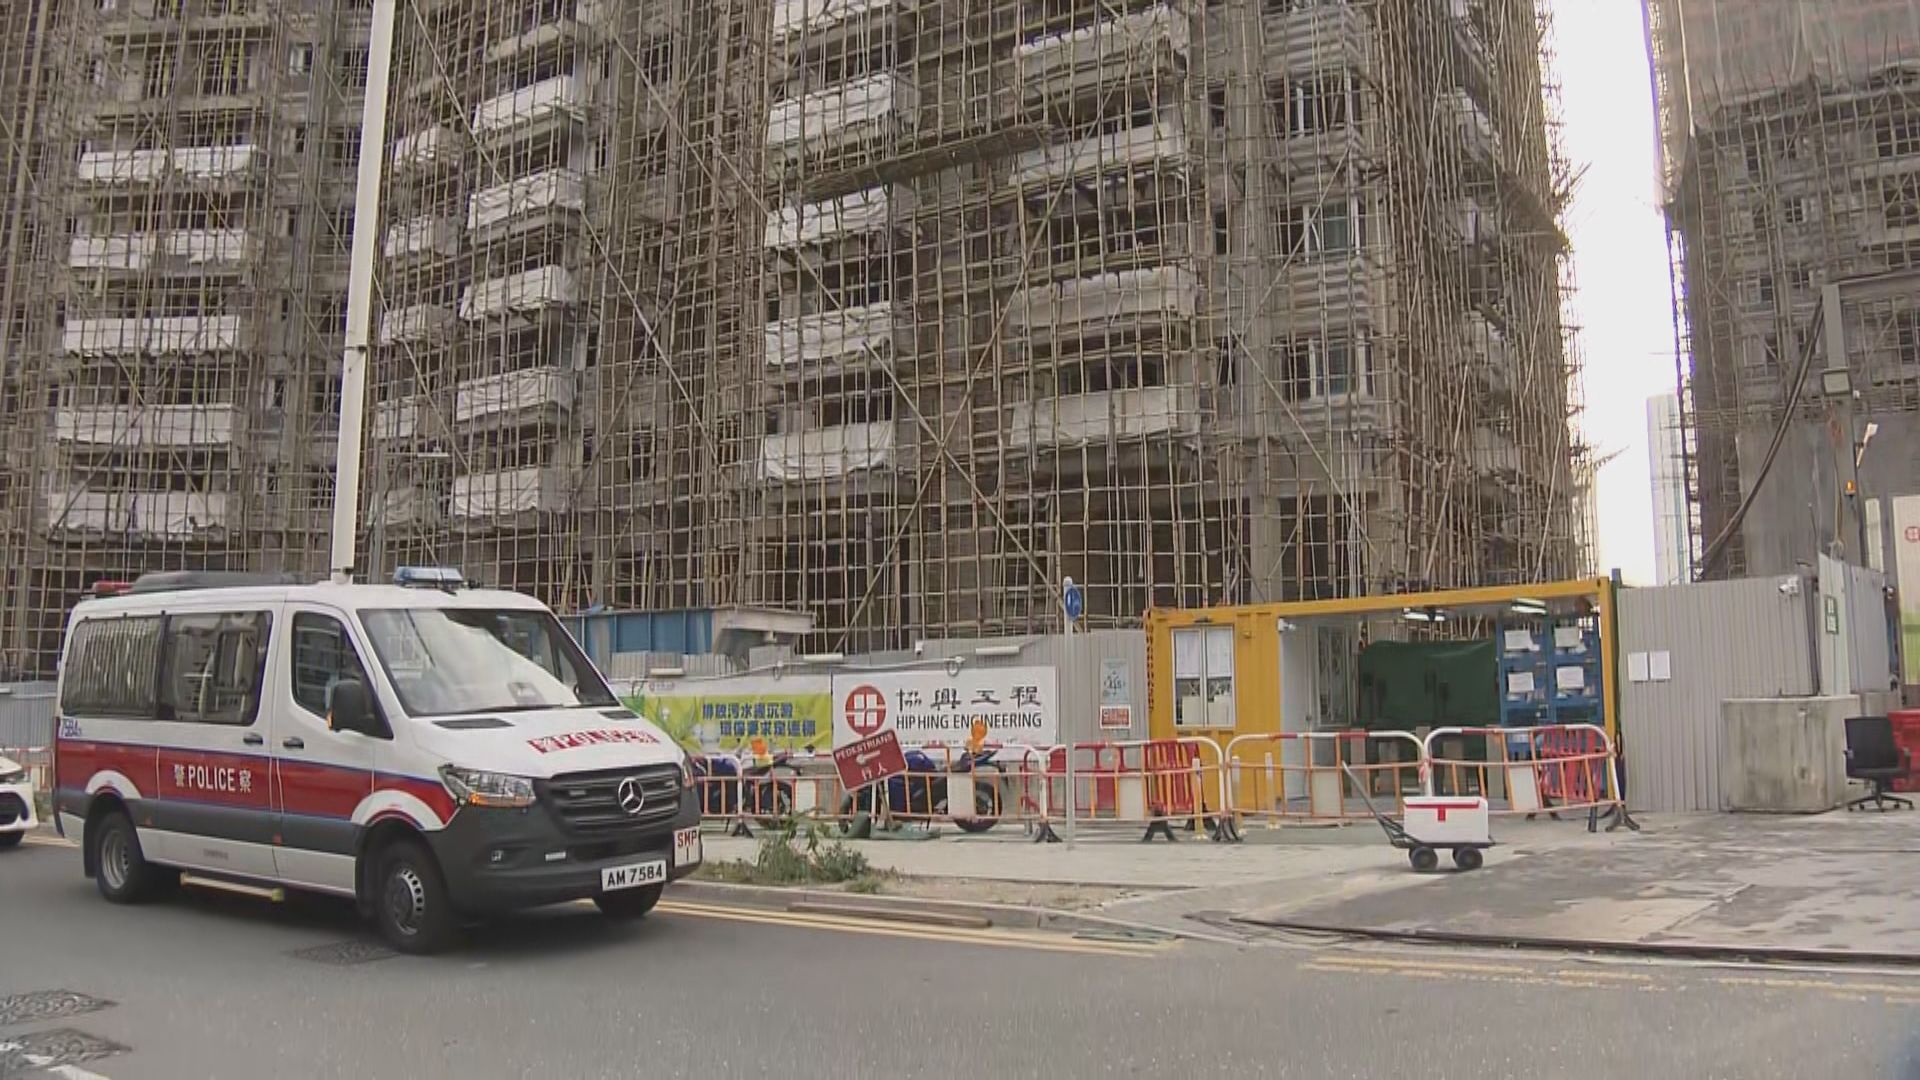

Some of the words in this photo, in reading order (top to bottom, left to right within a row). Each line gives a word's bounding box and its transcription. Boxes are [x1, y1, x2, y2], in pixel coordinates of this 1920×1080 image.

[896, 714, 915, 730] HIP
[917, 713, 949, 730] HING
[953, 712, 1042, 730] ENGINEERING
[835, 732, 894, 761] PEDESTRIANS
[174, 764, 185, 787] 警
[188, 765, 235, 791] POLICE
[861, 762, 888, 780] 行人
[677, 829, 697, 848] SMP
[607, 869, 626, 887] AM
[630, 863, 662, 884] 7584
